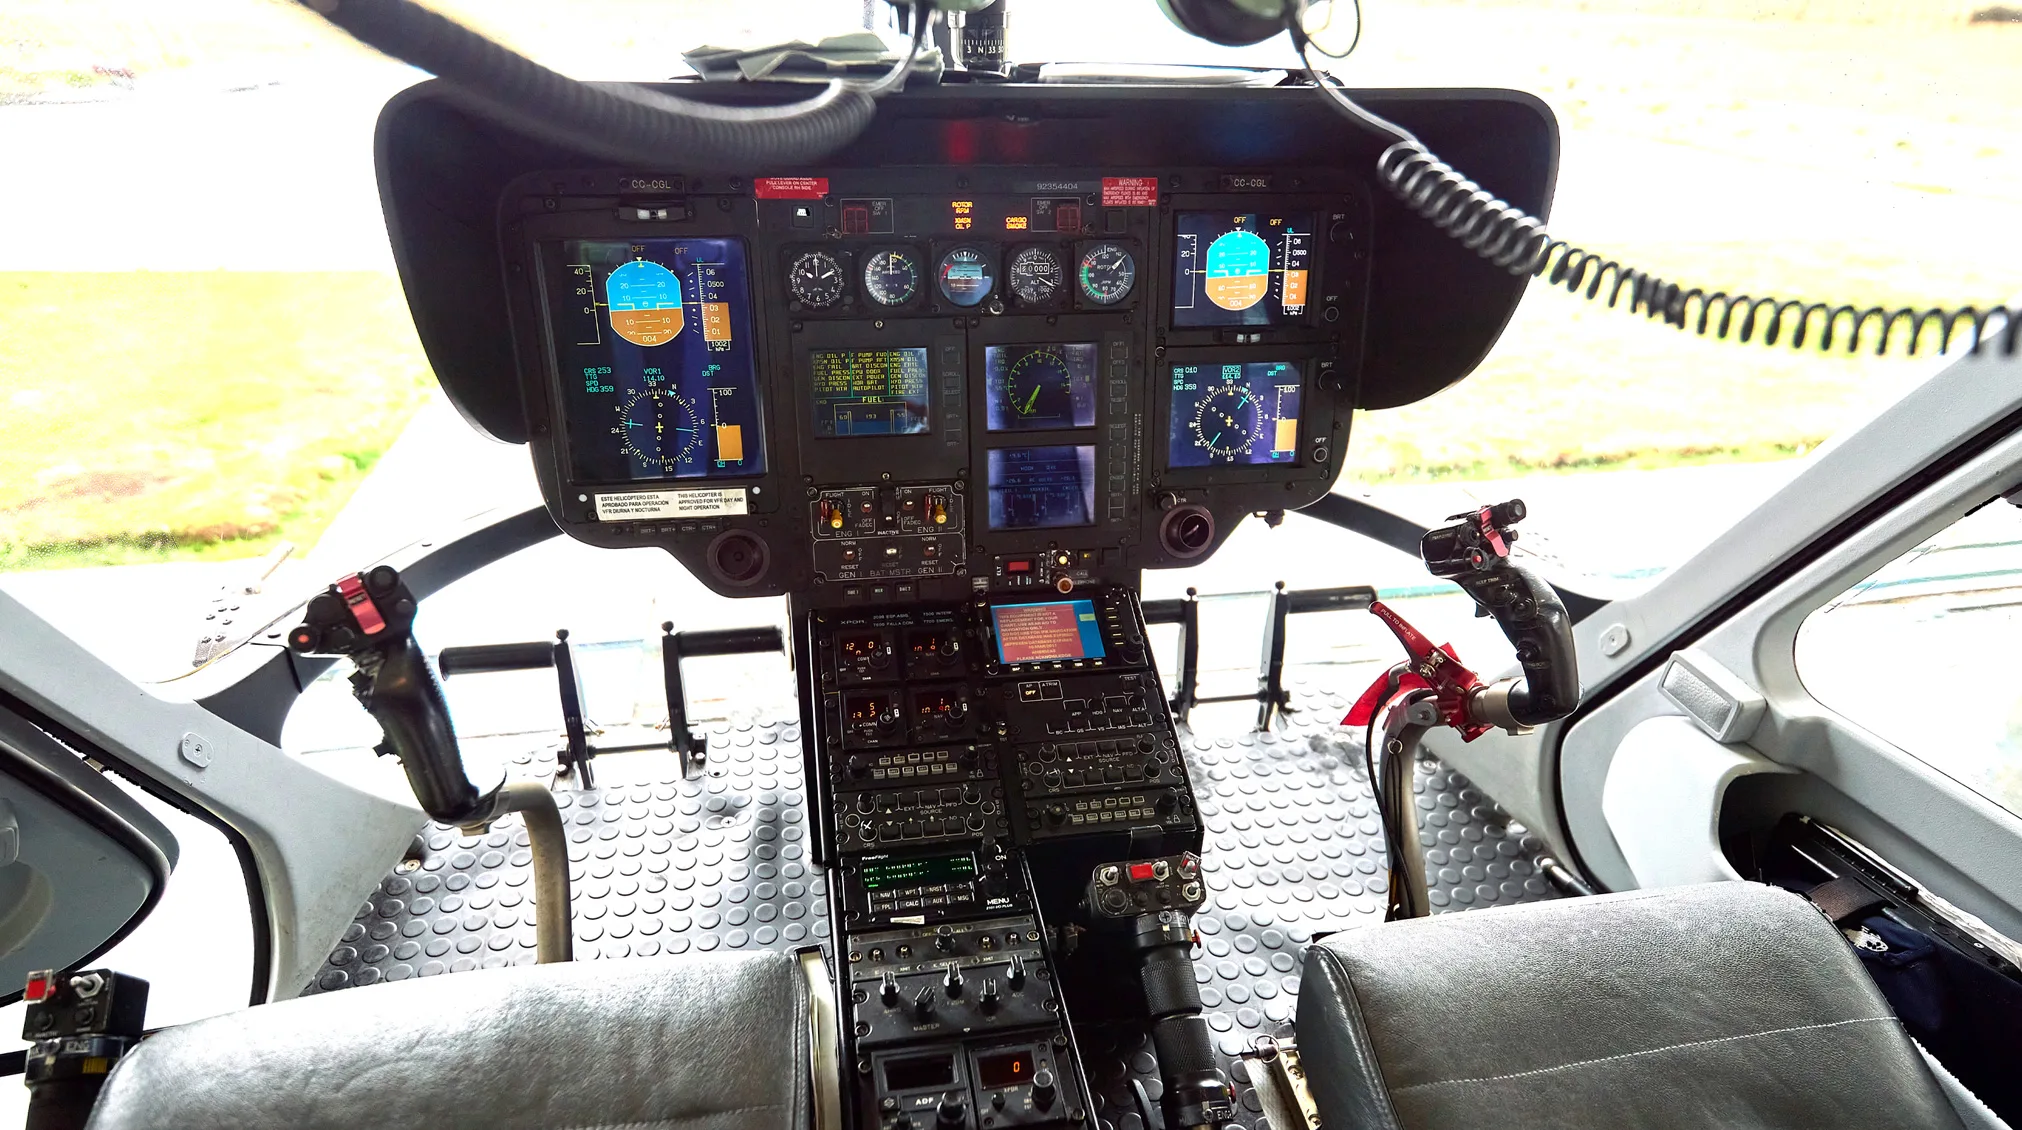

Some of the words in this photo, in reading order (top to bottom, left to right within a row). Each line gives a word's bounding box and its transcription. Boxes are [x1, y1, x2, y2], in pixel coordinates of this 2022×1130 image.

[632, 180, 671, 189] CC-CGL
[1234, 179, 1267, 187] CC-CGL
[1381, 609, 1392, 619] PULL
[1399, 624, 1416, 640] INFLATE
[914, 1023, 940, 1032] MASTER
[66, 1040, 90, 1052] ENG
[1013, 1062, 1020, 1073] 0
[916, 1097, 934, 1106] ADF
